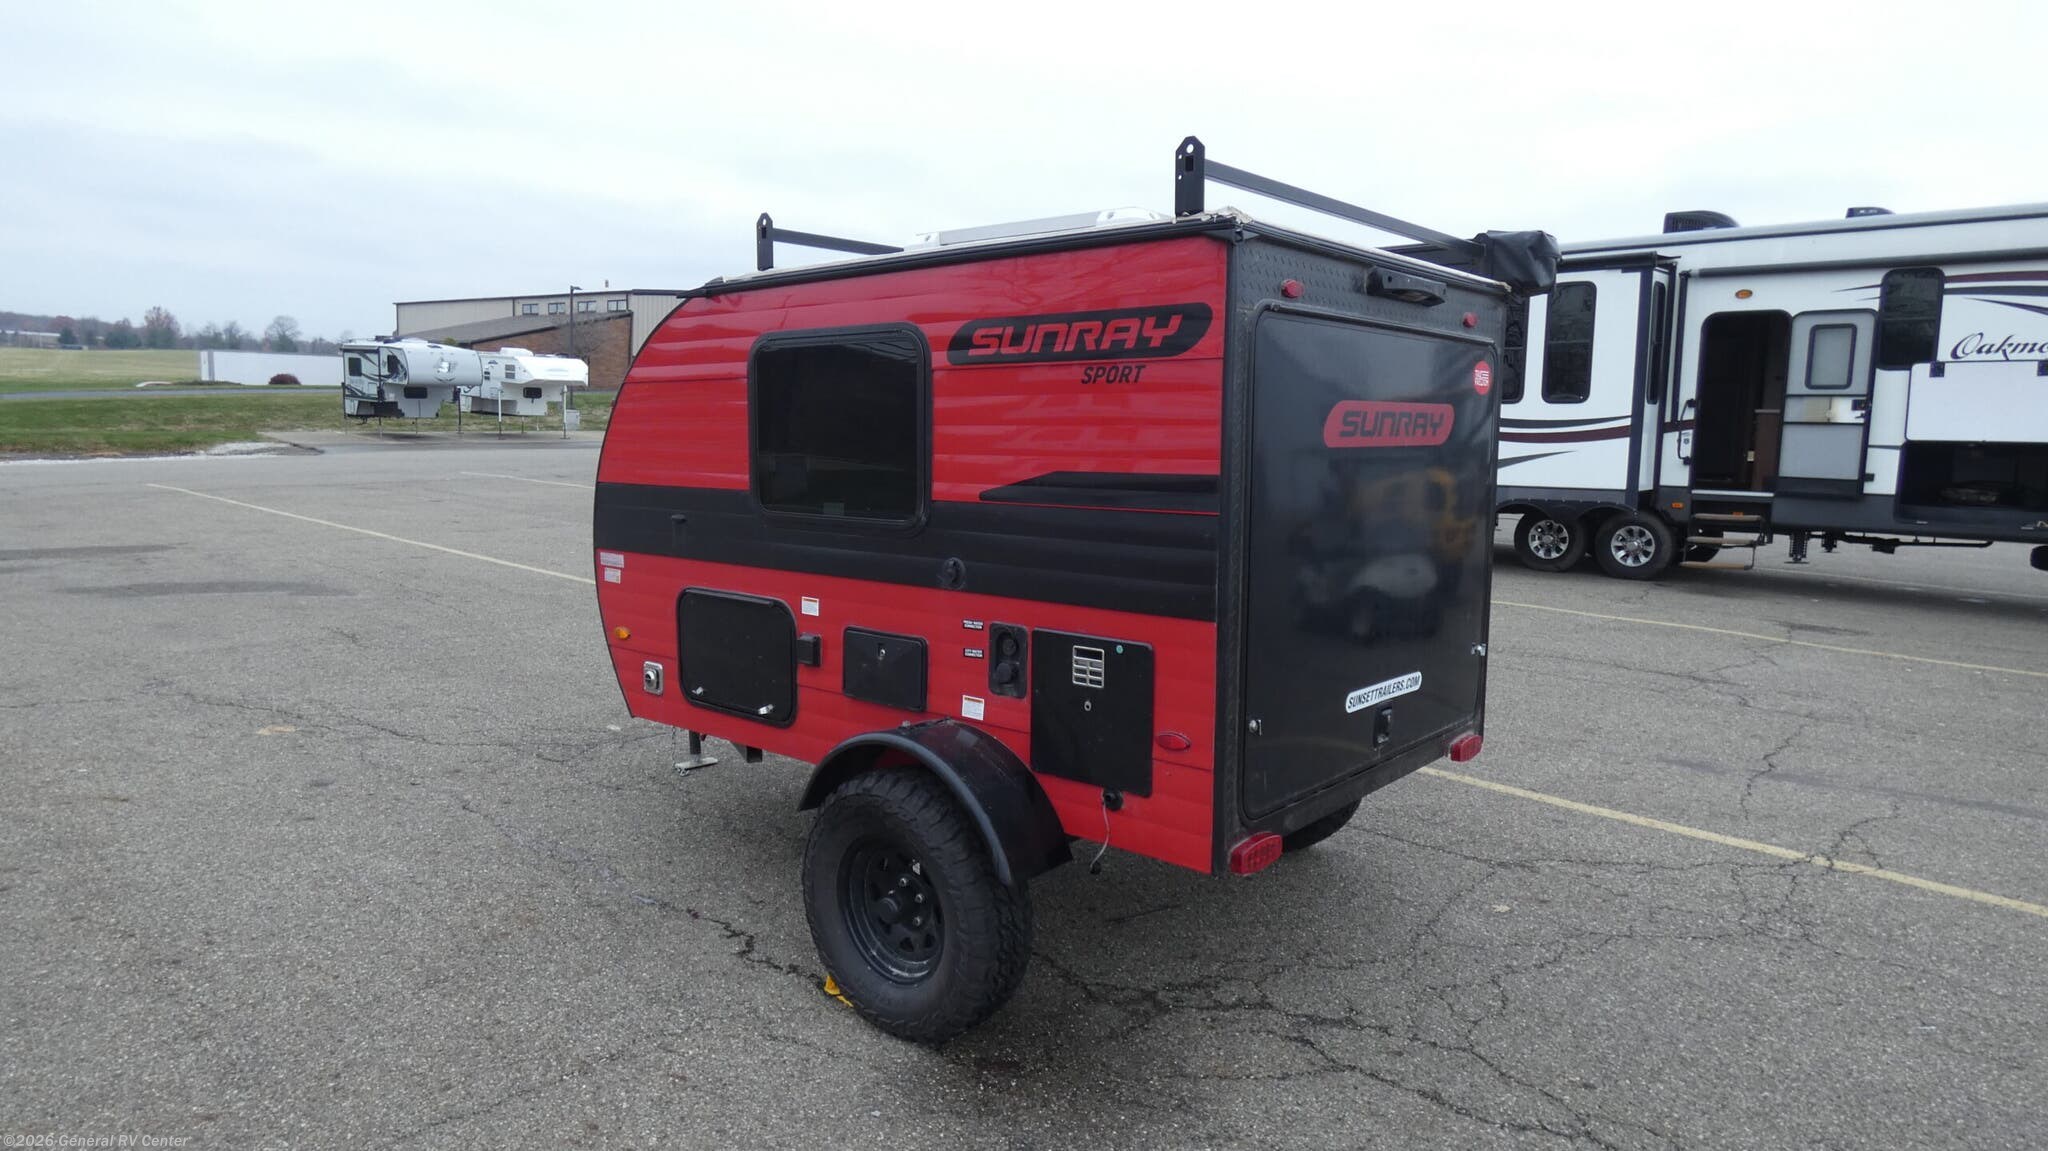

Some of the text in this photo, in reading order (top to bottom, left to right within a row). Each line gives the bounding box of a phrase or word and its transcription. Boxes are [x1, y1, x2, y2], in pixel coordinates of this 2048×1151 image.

[968, 314, 1183, 356] SUNRAY
[1081, 364, 1147, 384] SPORT
[1340, 411, 1444, 437] SUNRAY
[1347, 674, 1421, 709] SUNSETTRAILERS.COM
